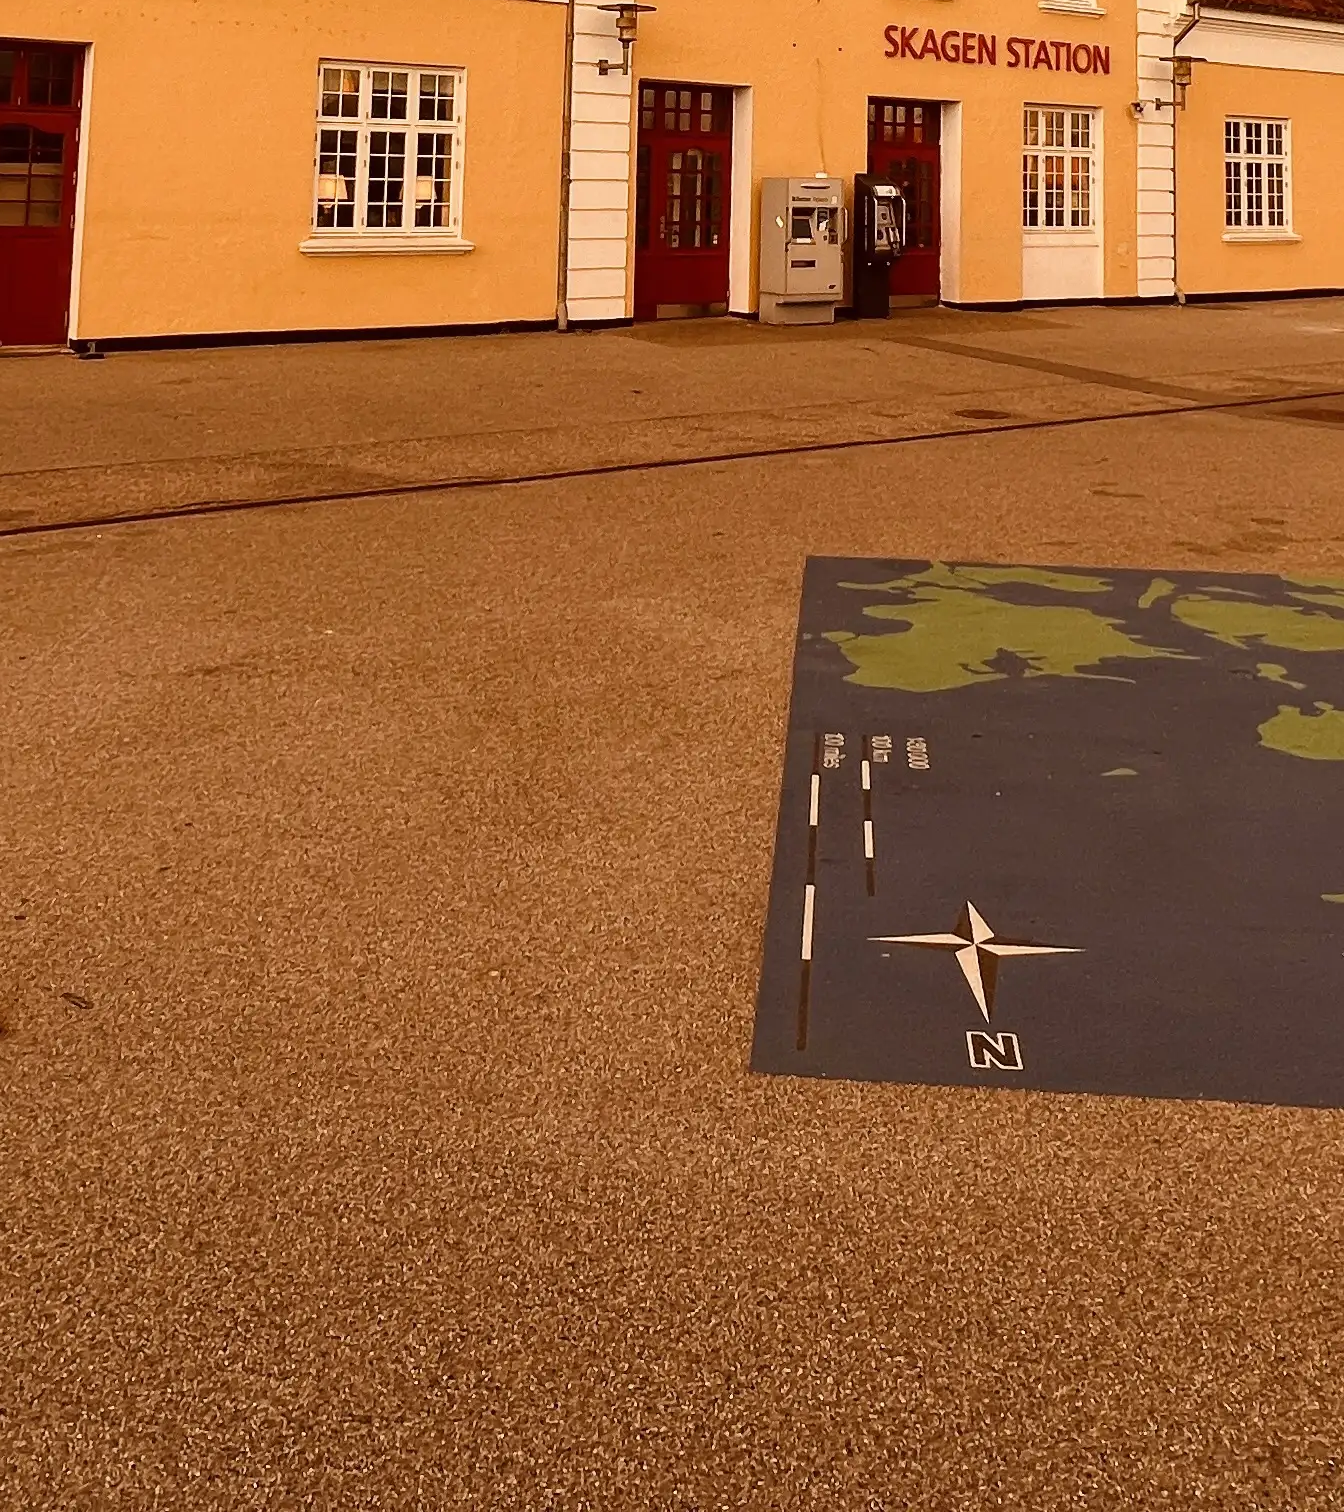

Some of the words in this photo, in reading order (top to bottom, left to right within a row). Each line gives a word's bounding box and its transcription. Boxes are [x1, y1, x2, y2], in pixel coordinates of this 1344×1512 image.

[884, 25, 997, 66] SKAGEN
[1007, 37, 1111, 75] STATION
[966, 1030, 1024, 1071] N
